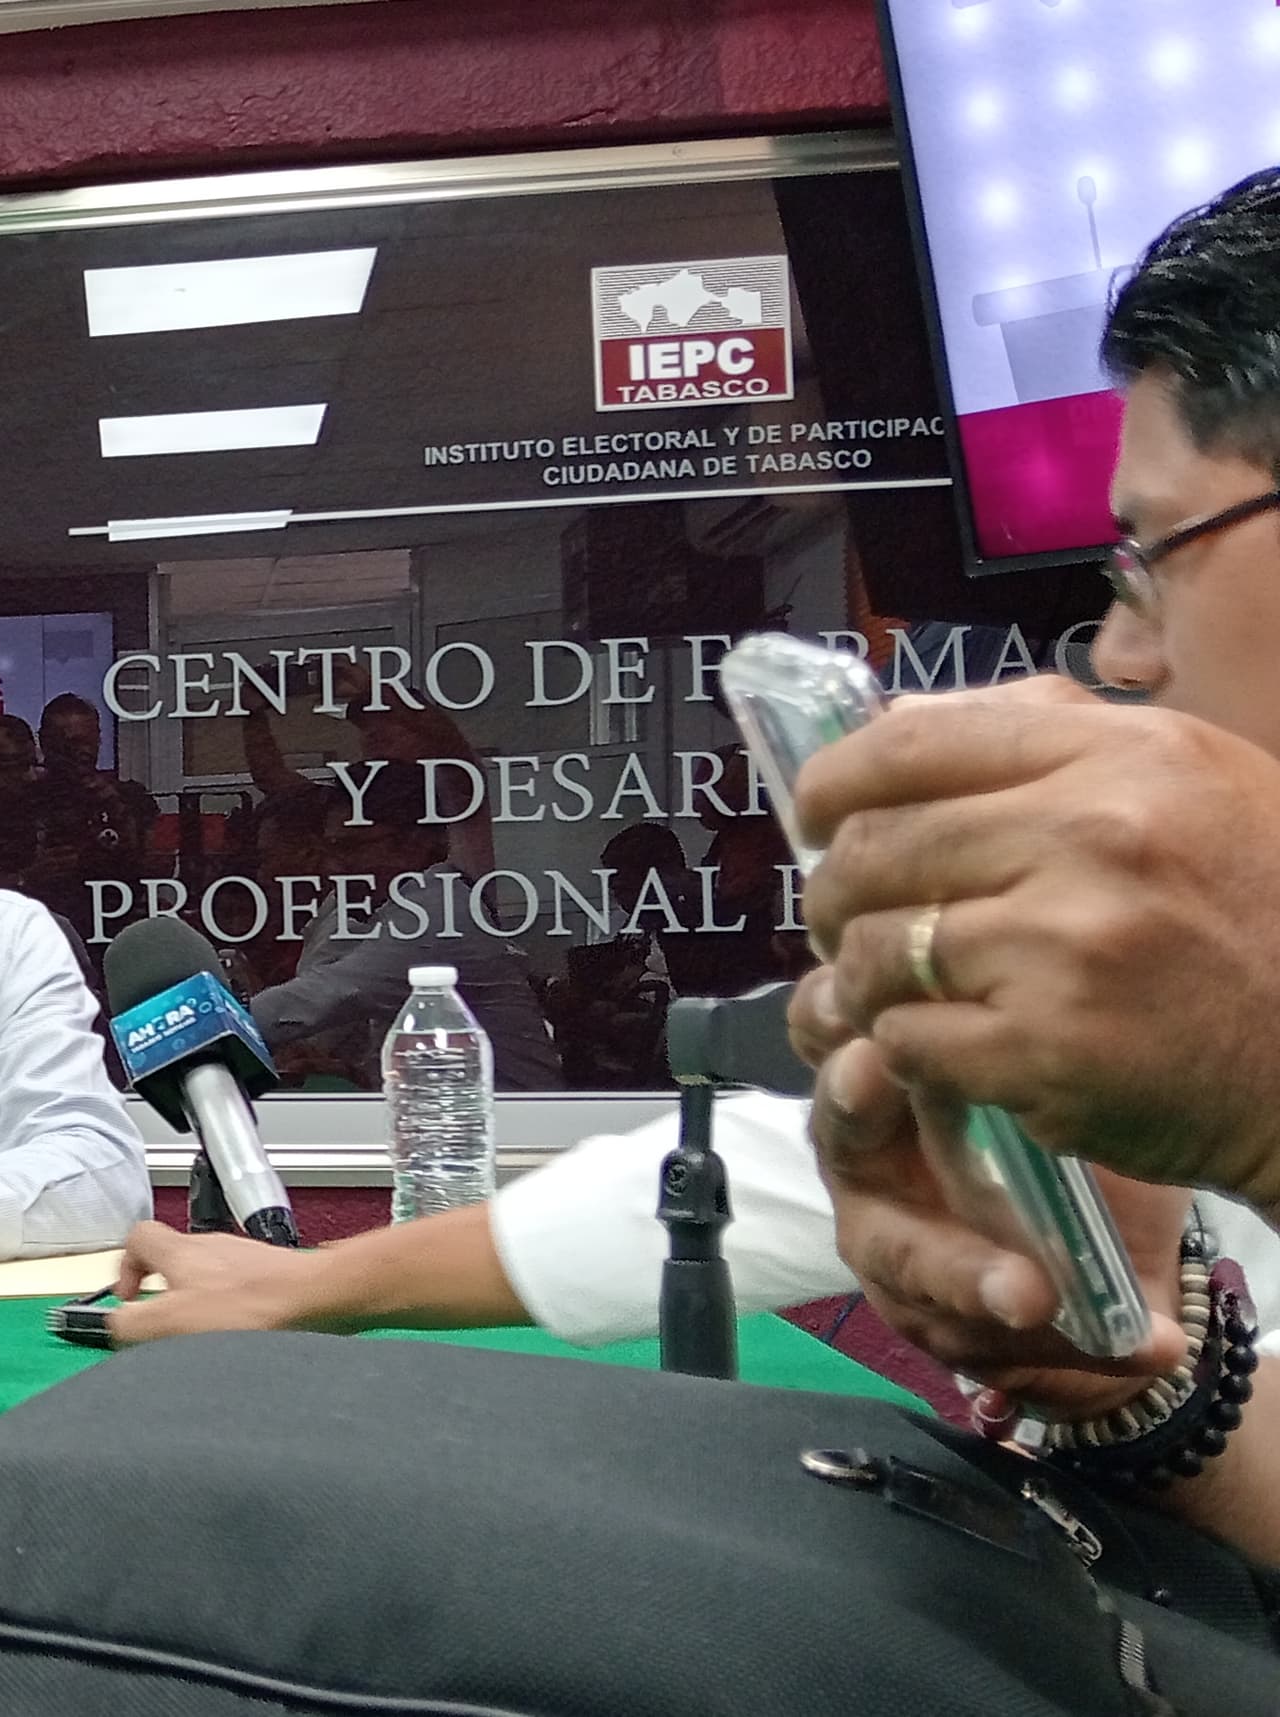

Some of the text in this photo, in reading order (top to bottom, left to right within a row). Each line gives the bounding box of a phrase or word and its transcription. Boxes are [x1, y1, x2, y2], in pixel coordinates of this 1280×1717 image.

[629, 338, 755, 381] IEPC
[616, 377, 769, 404] TABASCO
[425, 416, 944, 466] INSTITUTO ELECTORAL Y DE PARTICIPAC
[543, 449, 872, 487] CIUDADANA DE TABASCO
[102, 641, 496, 720] CENTRO
[524, 637, 655, 708] DE
[326, 760, 390, 827] Y
[85, 866, 747, 944] PROFESIONAL
